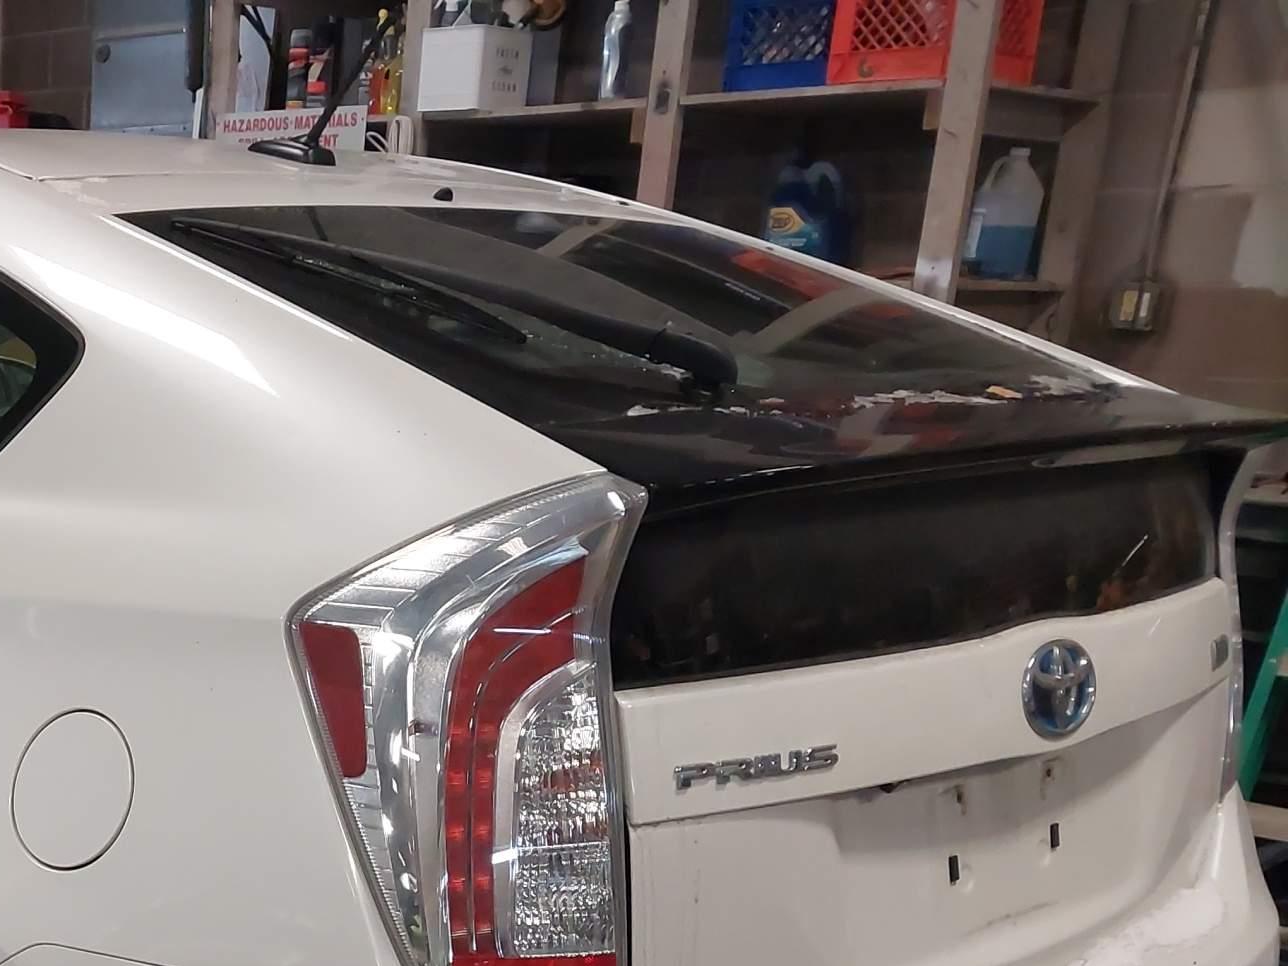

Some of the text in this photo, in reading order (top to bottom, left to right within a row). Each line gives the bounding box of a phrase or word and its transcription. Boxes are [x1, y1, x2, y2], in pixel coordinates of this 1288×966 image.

[223, 112, 357, 133] HAZARDOUS MATIALS
[675, 744, 839, 790] PRIUS
